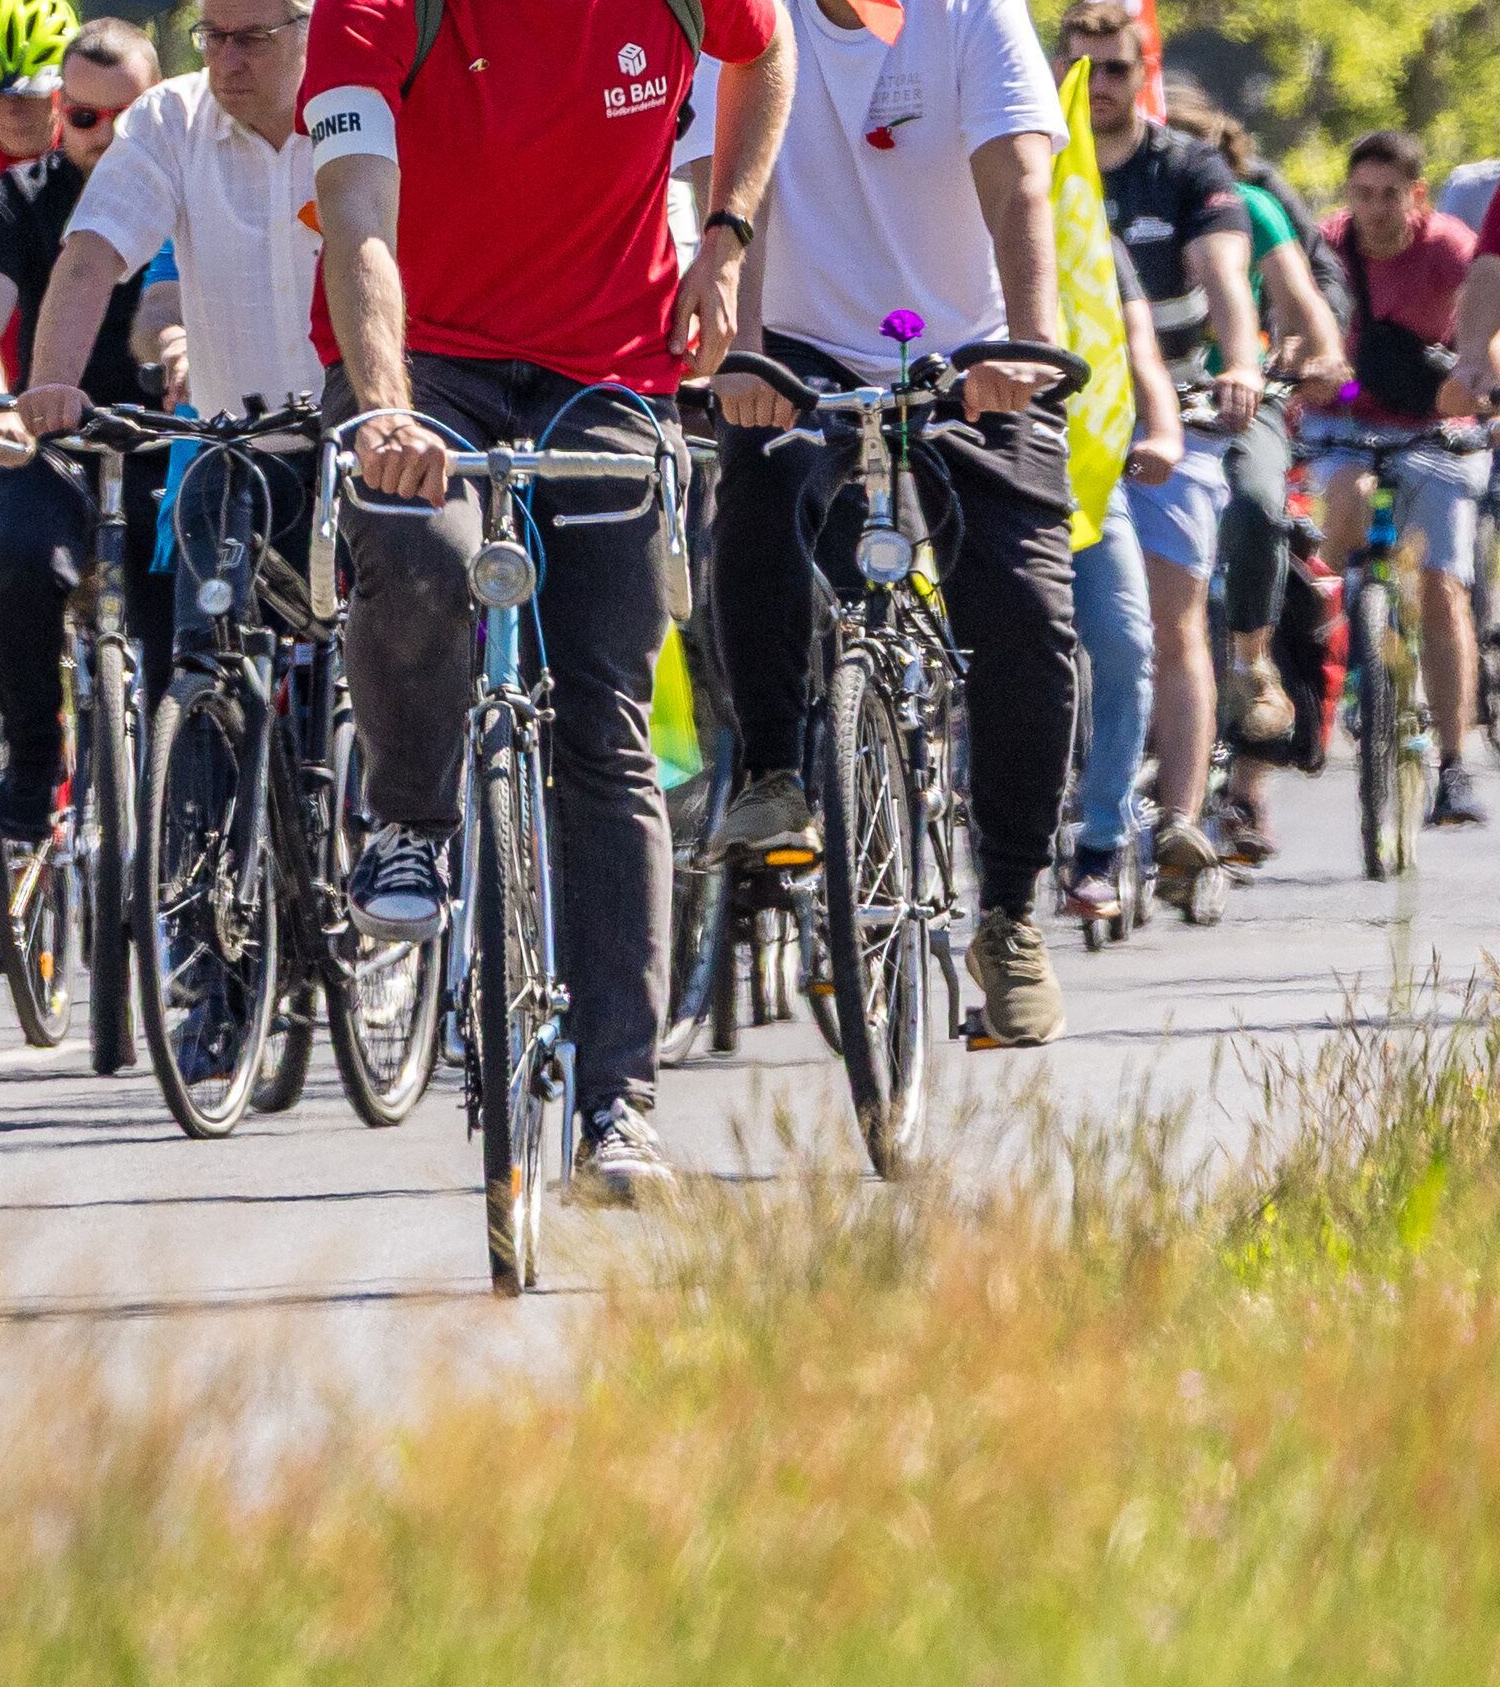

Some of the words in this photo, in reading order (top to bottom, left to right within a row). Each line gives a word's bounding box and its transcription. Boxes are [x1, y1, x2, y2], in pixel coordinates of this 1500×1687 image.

[603, 87, 626, 109] IG
[630, 76, 667, 103] BAU
[311, 112, 362, 149] RDNER
